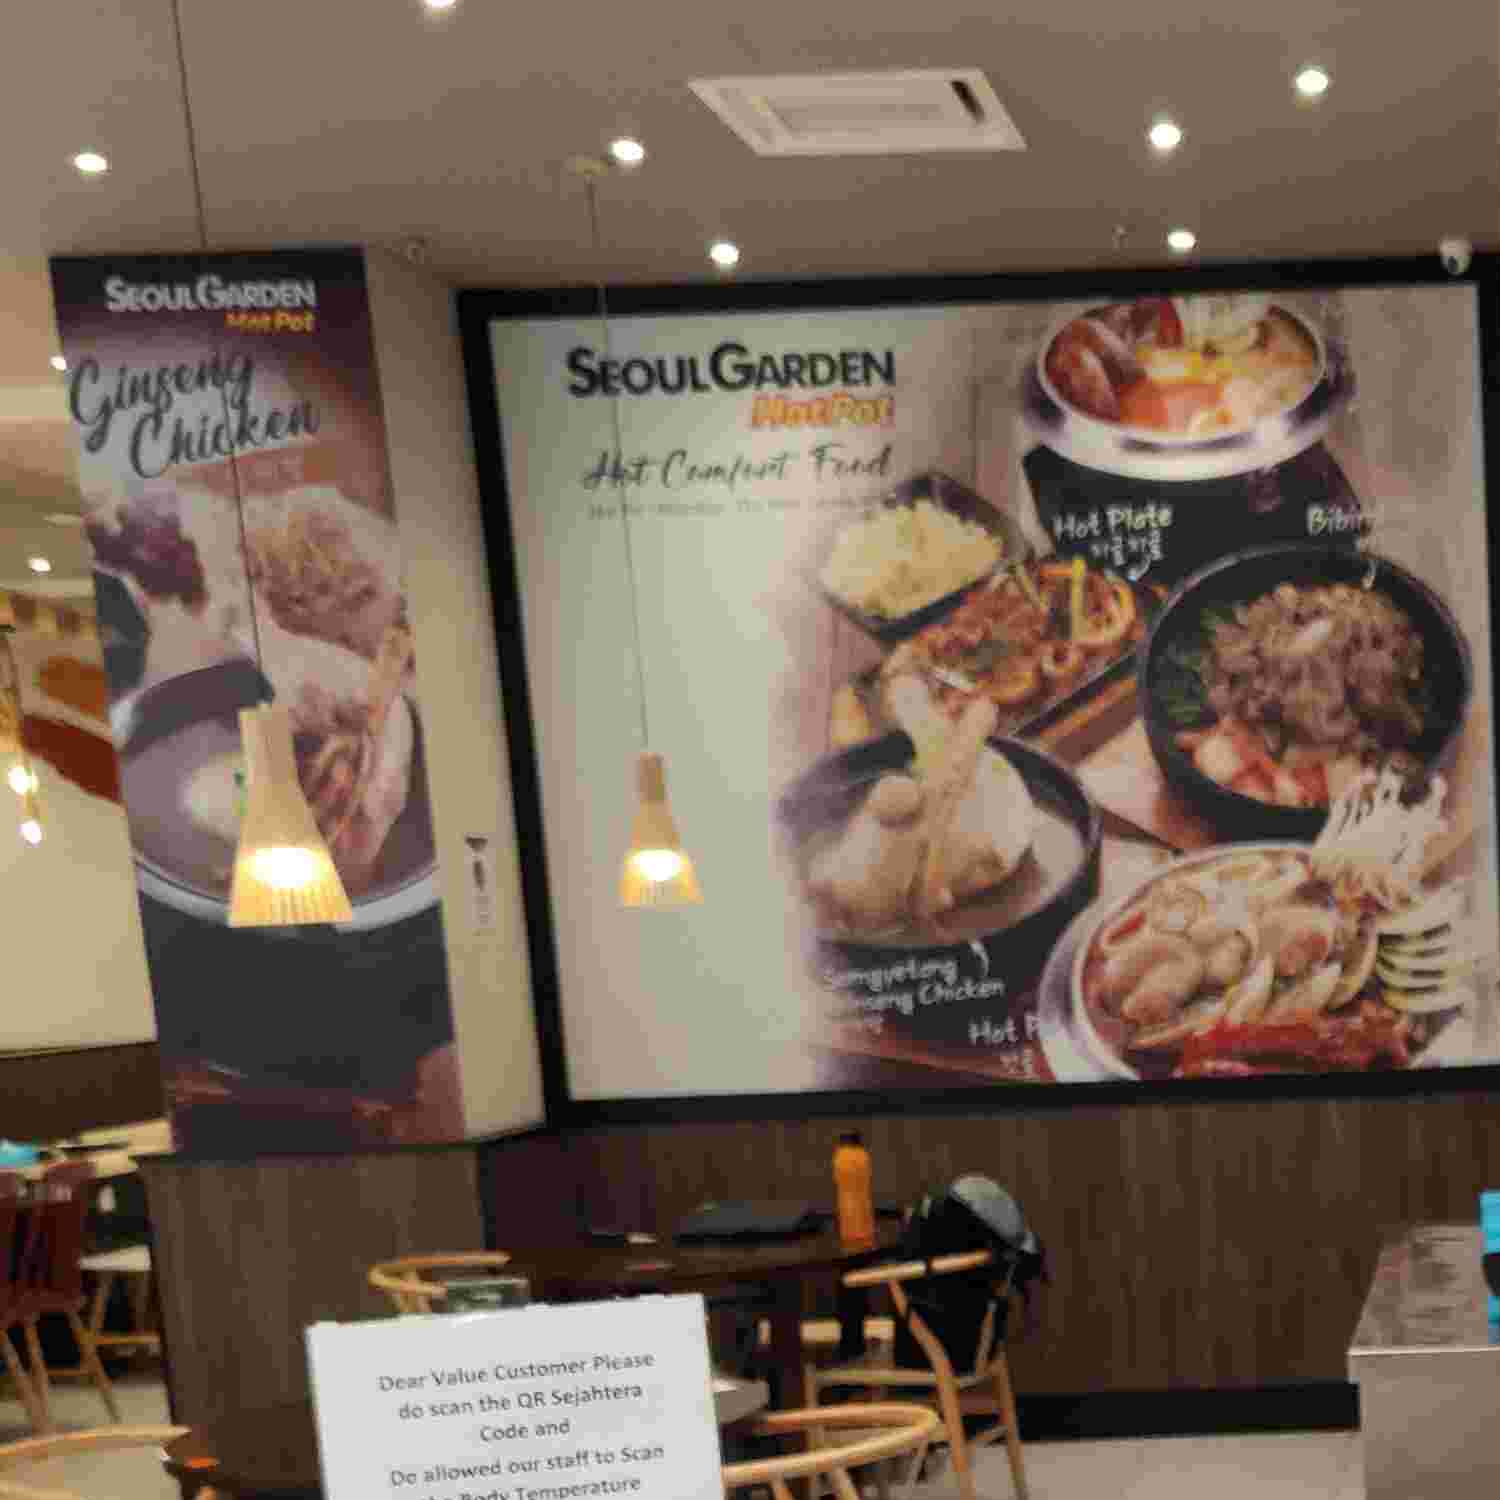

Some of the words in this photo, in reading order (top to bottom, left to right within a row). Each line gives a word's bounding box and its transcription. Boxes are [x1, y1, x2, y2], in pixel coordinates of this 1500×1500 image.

[68, 350, 254, 453] Ginseng
[131, 400, 319, 478] Chicken
[1053, 511, 1099, 541] Hot
[1106, 503, 1173, 534] Plate
[967, 1015, 1018, 1046] Hot
[378, 1372, 428, 1392] Dear
[432, 1366, 487, 1388] Value
[494, 1358, 587, 1383] Customer
[593, 1351, 655, 1374] Please
[399, 1402, 424, 1420] do
[430, 1400, 474, 1420] scan
[479, 1393, 511, 1414] the
[517, 1391, 547, 1412] QR
[551, 1383, 643, 1409] Sejahtera
[480, 1424, 529, 1443] Code
[535, 1418, 571, 1437] and
[423, 1461, 501, 1485] allowed
[508, 1458, 540, 1475] our
[545, 1450, 591, 1473] staff
[595, 1448, 616, 1466] to
[620, 1443, 665, 1464] Scan
